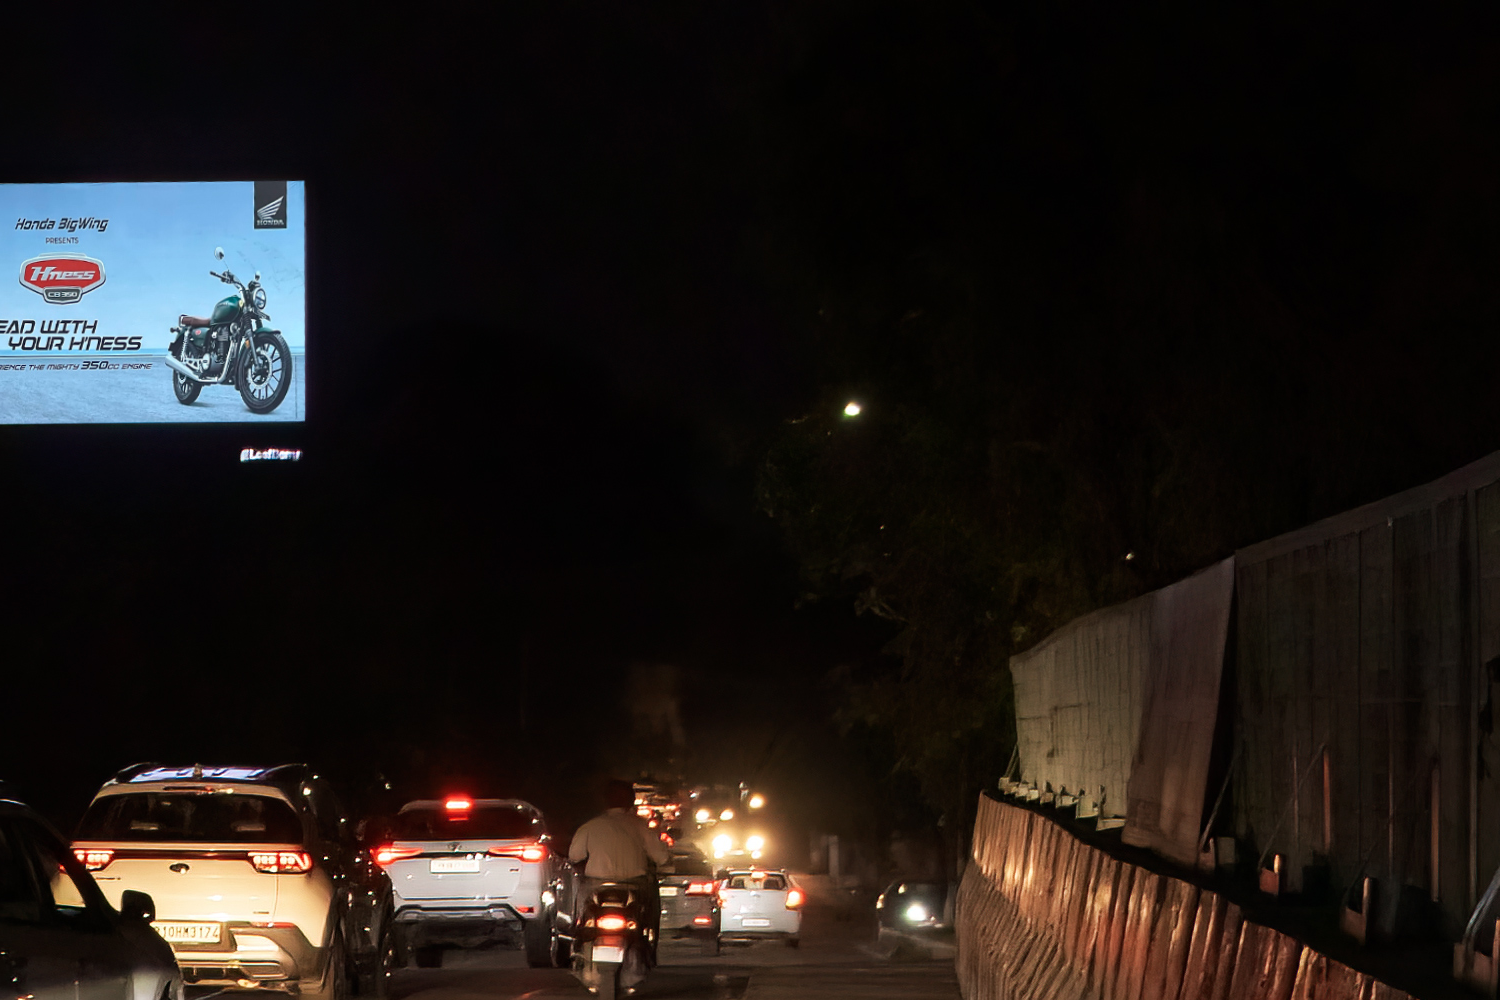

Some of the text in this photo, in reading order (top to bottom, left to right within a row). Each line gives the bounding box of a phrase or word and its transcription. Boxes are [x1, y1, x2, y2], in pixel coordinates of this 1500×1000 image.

[15, 217, 109, 233] Honda BigWing
[45, 236, 79, 245] PRESENTS
[40, 319, 98, 334] WITH
[8, 336, 64, 351] YOUR
[46, 363, 80, 371] MIGHTY
